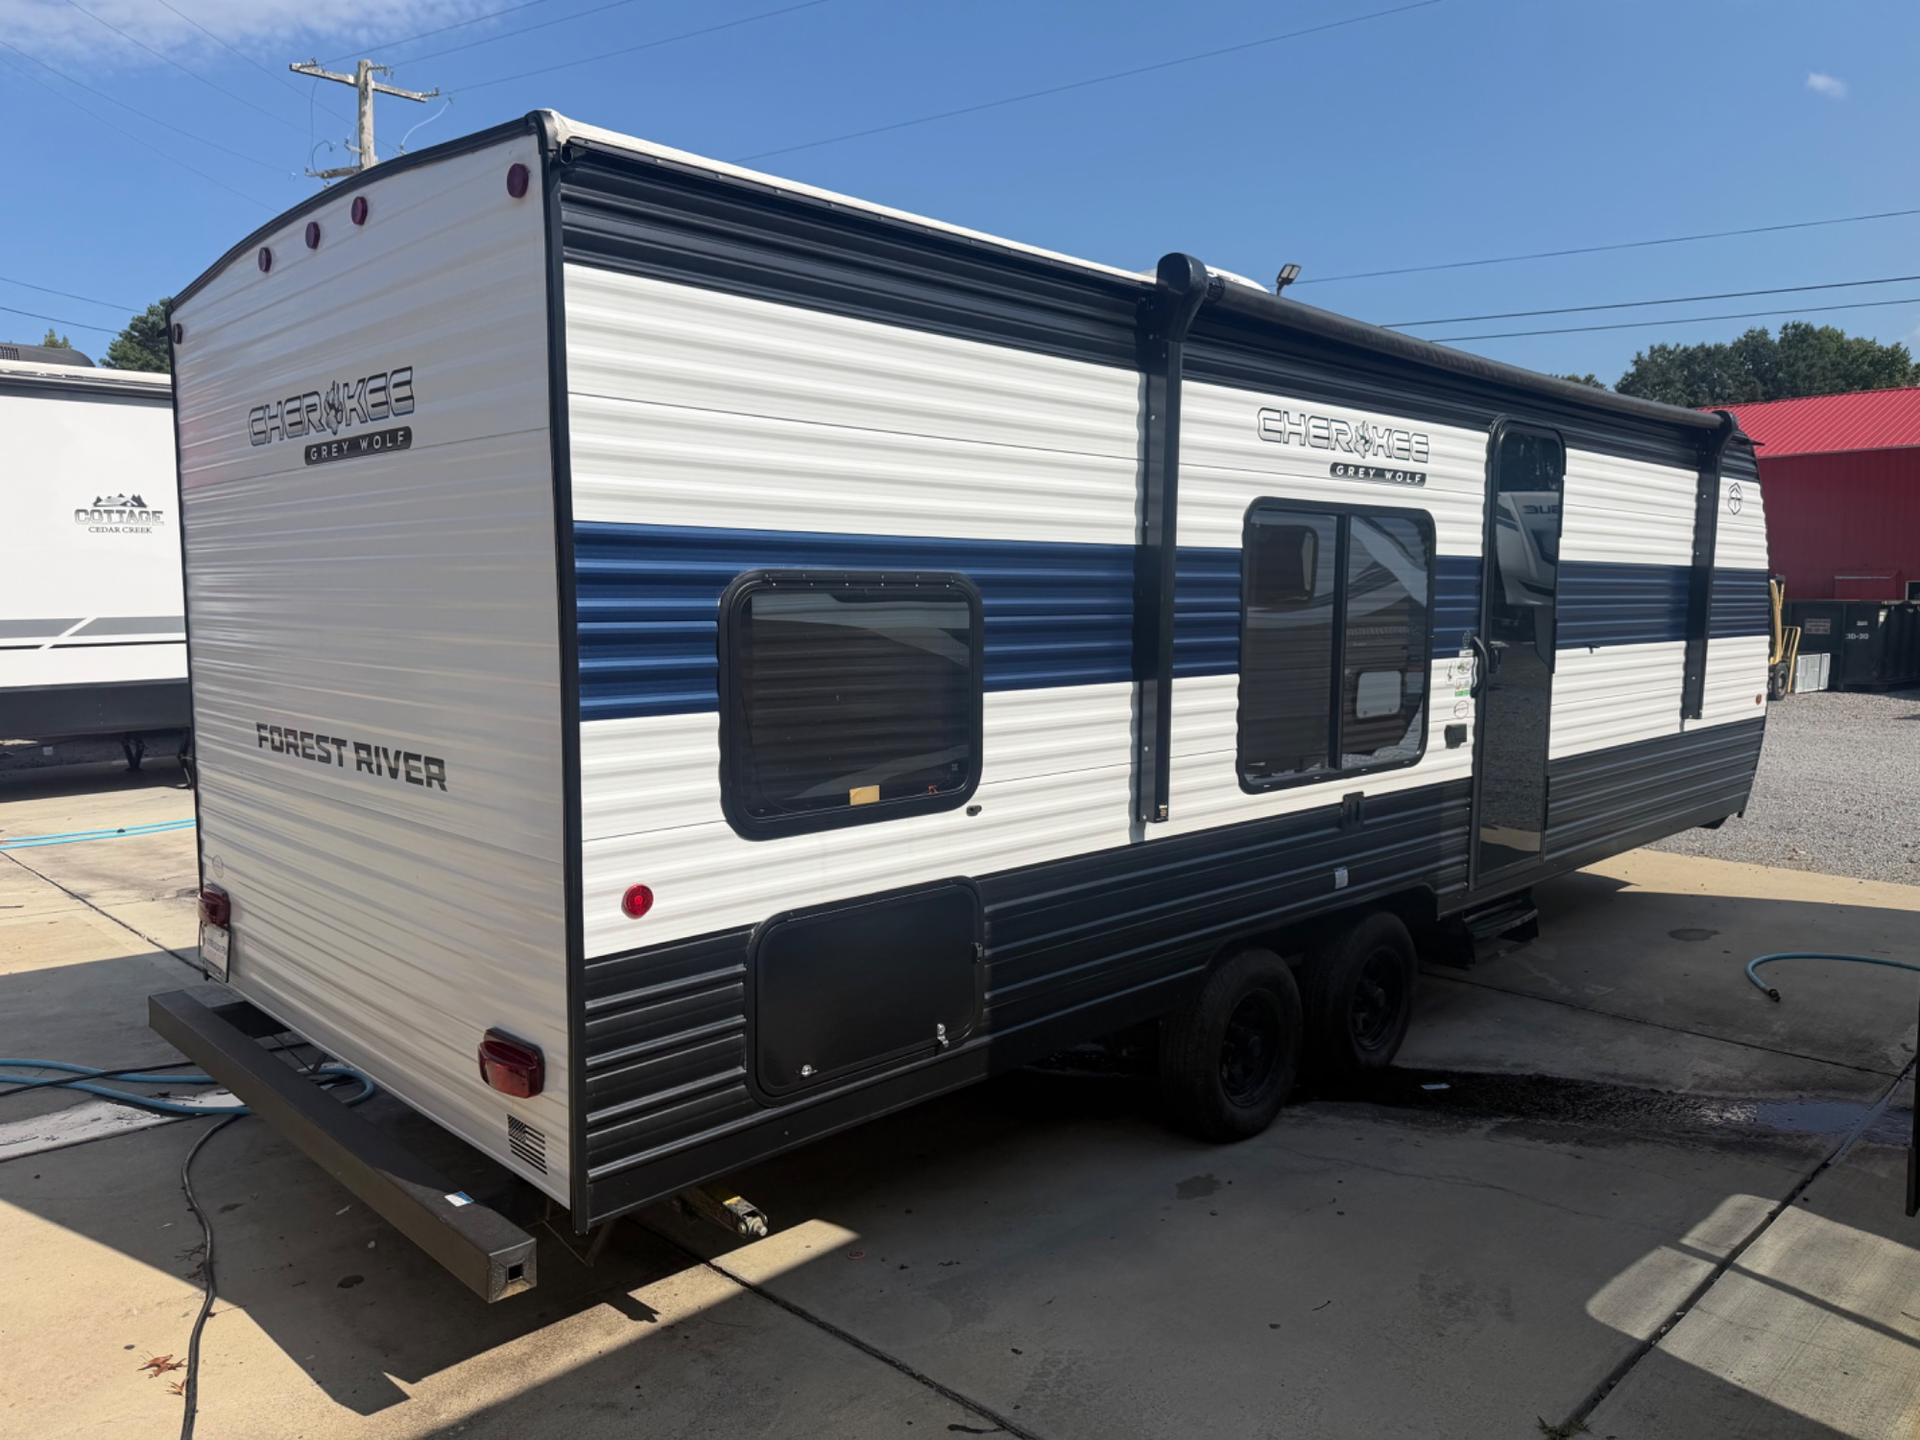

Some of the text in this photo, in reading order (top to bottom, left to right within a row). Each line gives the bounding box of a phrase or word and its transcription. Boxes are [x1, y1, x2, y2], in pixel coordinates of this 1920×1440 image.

[310, 430, 405, 461] GREY WOLF
[1335, 464, 1422, 483] GREY WOLF
[74, 509, 164, 526] COTTAGE
[88, 526, 153, 534] CEDAR CREEK
[256, 722, 448, 792] FOREST RIVER
